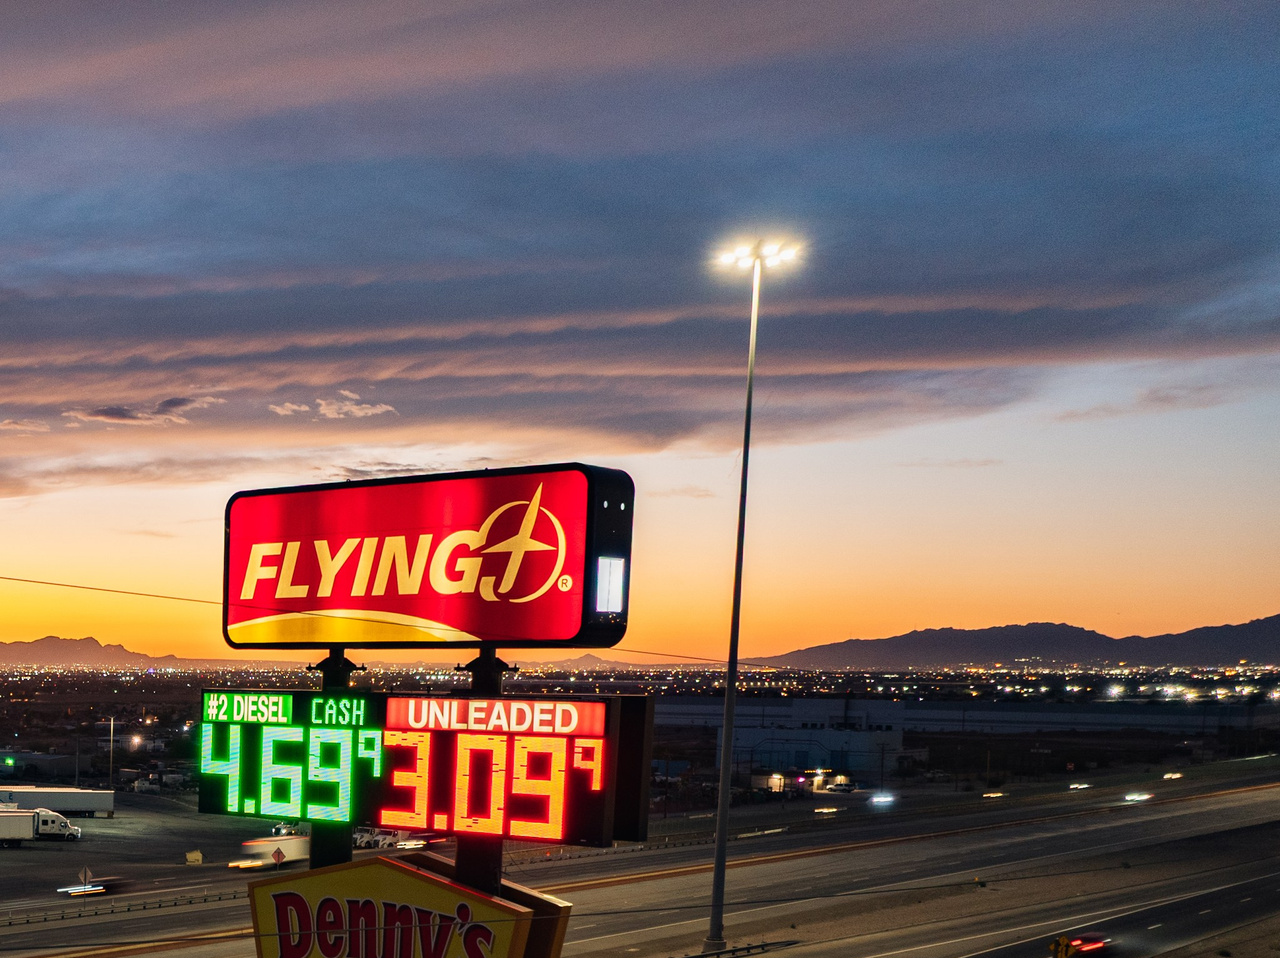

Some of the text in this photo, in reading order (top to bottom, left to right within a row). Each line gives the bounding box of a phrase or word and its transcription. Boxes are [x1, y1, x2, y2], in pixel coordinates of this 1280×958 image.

[239, 530, 486, 600] FLYING
[208, 694, 287, 723] #2 DIESEL
[312, 698, 365, 725] CASH
[408, 700, 578, 733] UNLEADED
